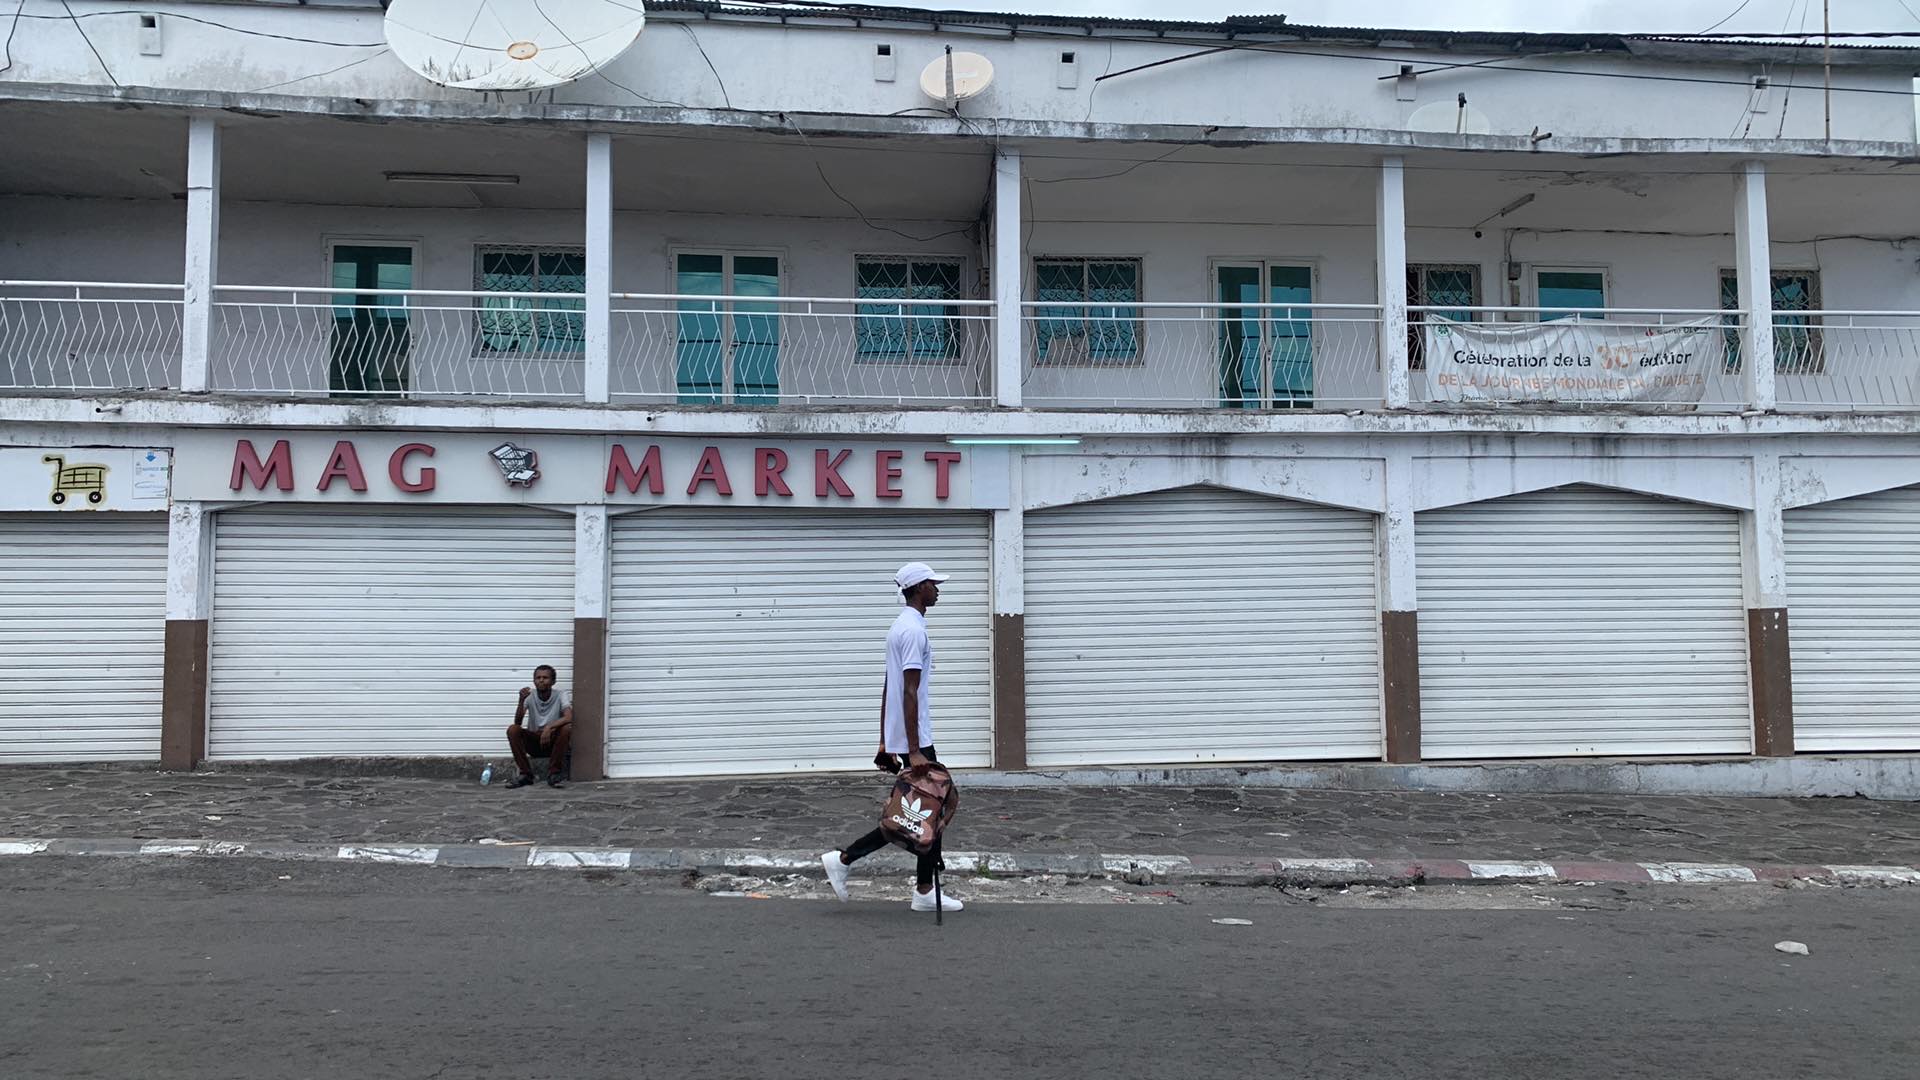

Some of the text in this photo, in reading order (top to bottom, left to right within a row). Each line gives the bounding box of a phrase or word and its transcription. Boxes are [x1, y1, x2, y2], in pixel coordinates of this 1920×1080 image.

[1453, 350, 1548, 367] Célébration
[1553, 353, 1574, 367] de
[1577, 352, 1592, 367] la
[1438, 373, 1457, 386] DE
[1461, 374, 1477, 387] LA
[230, 439, 962, 500] MAG MARKET
[892, 814, 925, 835] adidas
